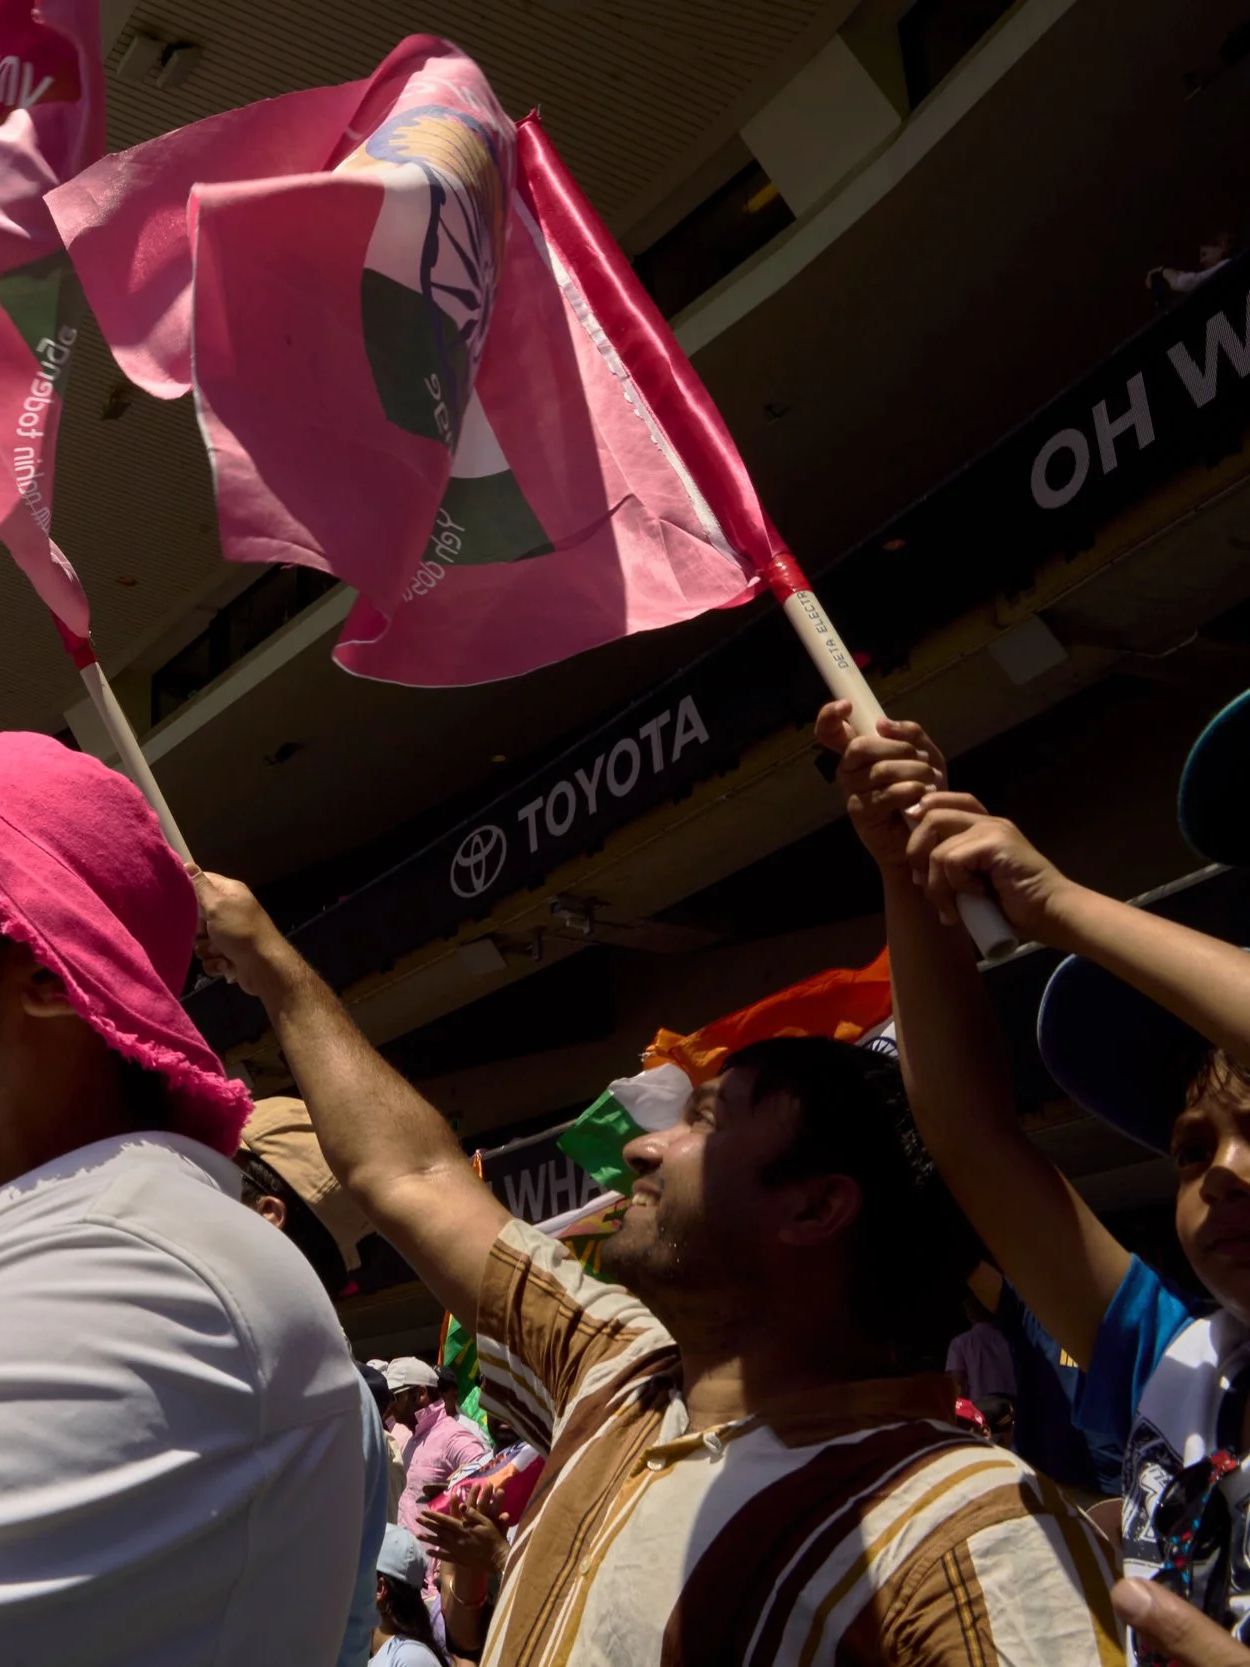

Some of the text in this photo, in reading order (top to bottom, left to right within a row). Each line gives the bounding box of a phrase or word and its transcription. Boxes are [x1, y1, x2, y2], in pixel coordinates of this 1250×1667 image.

[1029, 370, 1156, 511] OH
[825, 639, 850, 669] DETA
[517, 694, 710, 855] TOYOTA
